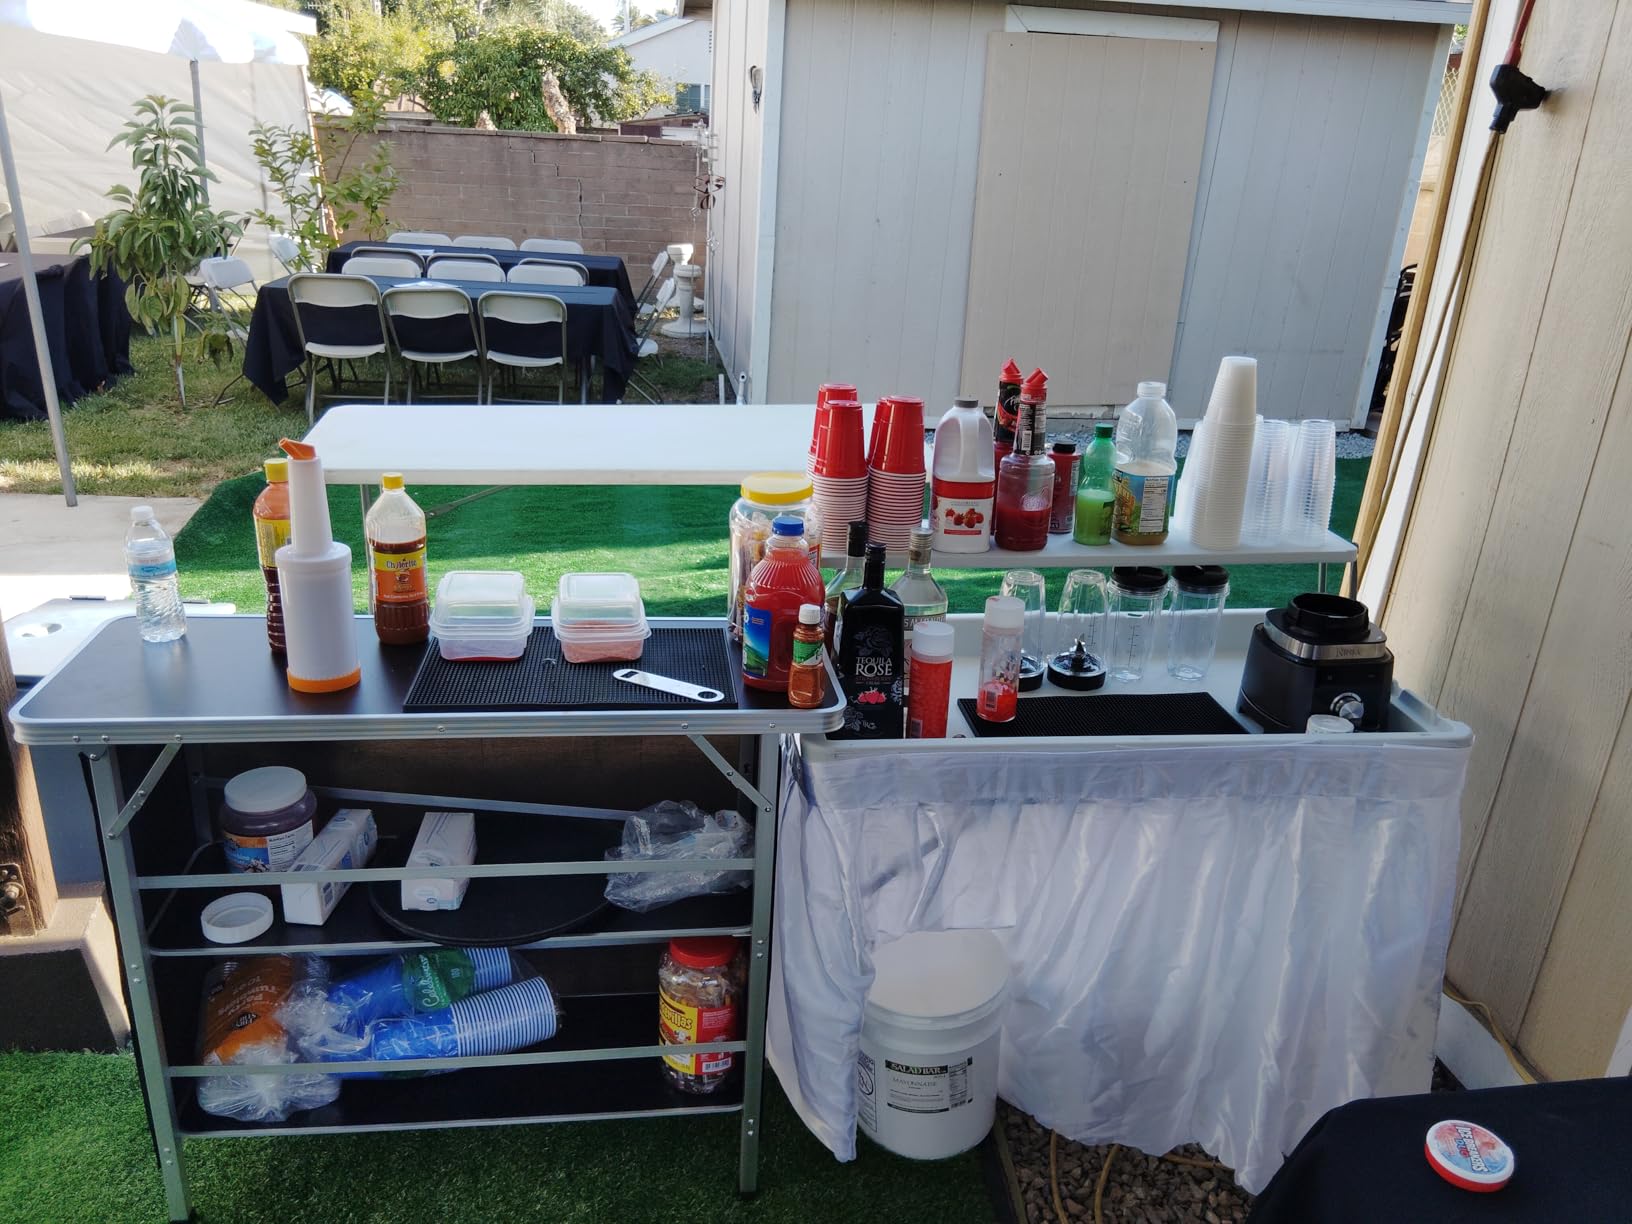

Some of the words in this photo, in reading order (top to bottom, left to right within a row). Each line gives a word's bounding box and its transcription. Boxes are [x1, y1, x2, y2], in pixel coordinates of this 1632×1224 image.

[855, 656, 893, 665] TEQUILA
[855, 663, 893, 677] ROSE
[891, 1062, 921, 1074] SALAD
[922, 1066, 940, 1074] BAR
[1455, 1126, 1473, 1140] ICE
